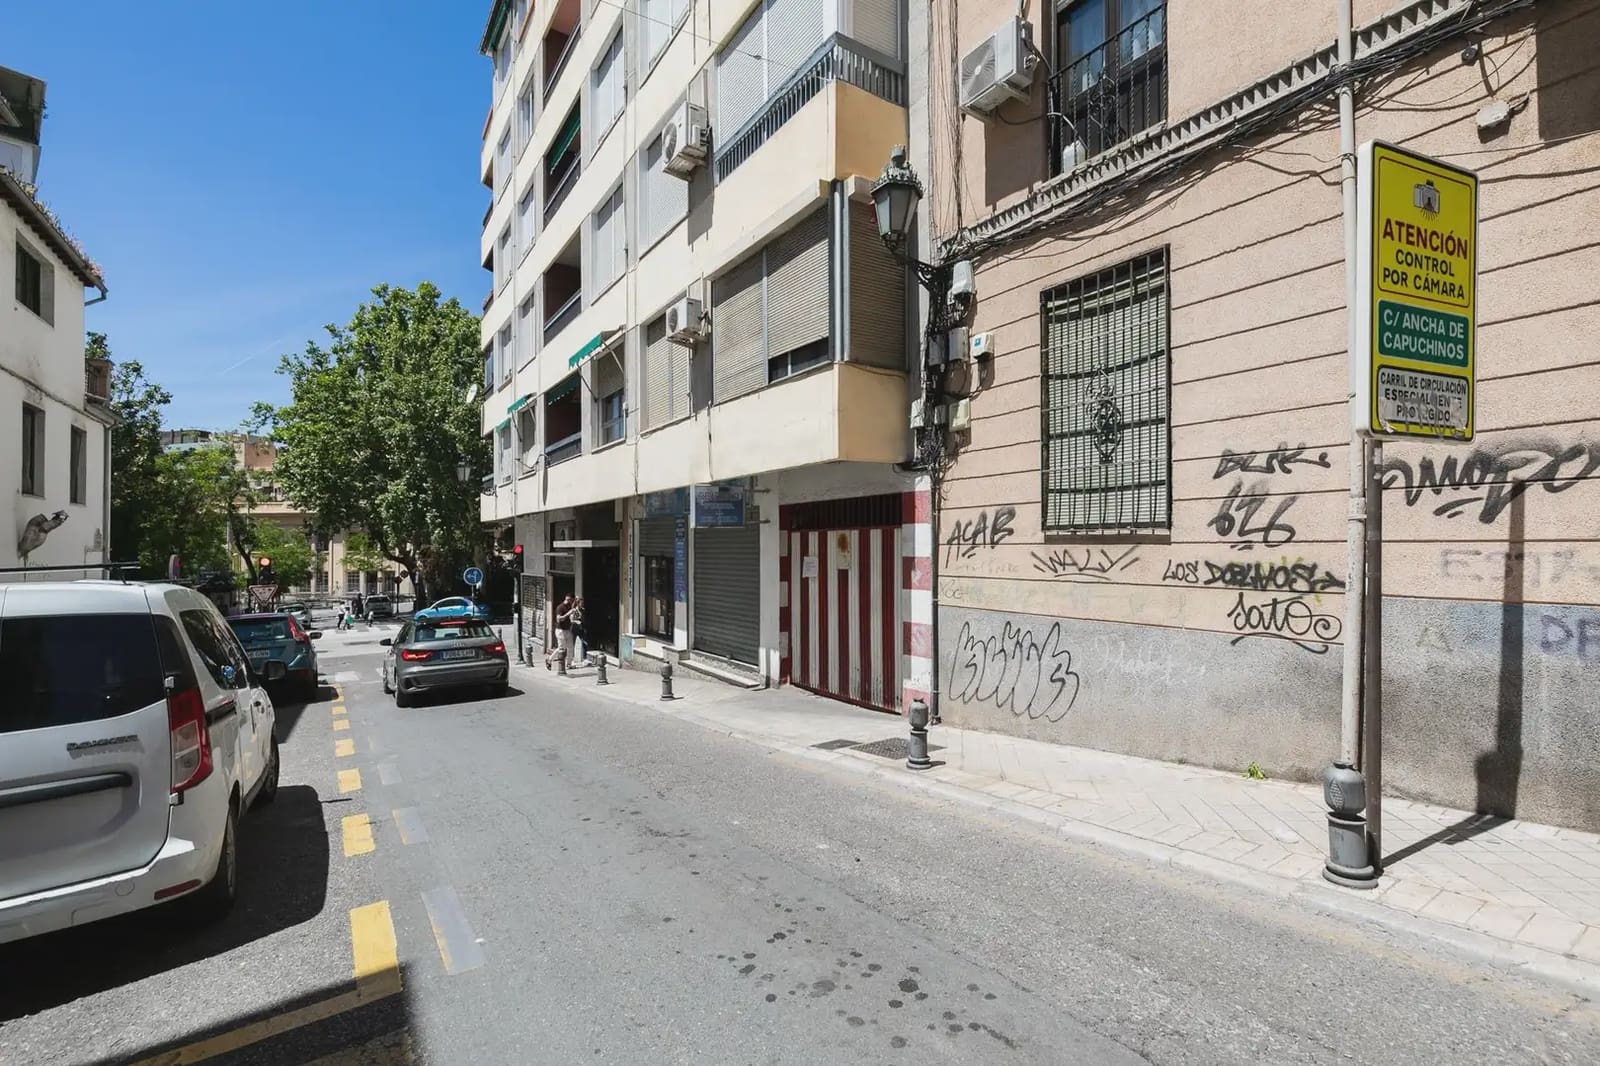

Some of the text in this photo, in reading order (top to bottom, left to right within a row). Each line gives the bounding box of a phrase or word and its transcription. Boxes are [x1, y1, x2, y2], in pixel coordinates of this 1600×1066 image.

[1382, 217, 1468, 260] ATENCIÓN
[1395, 248, 1455, 278] CONTROL
[1383, 266, 1465, 300] POR CÁMARA
[1383, 308, 1465, 339] C/ ANCHA DE
[1383, 331, 1465, 360] CAPUCHINOS
[1380, 371, 1467, 396] CARRIL DE CIRCULACIÓN
[1162, 558, 1200, 584] LOS
